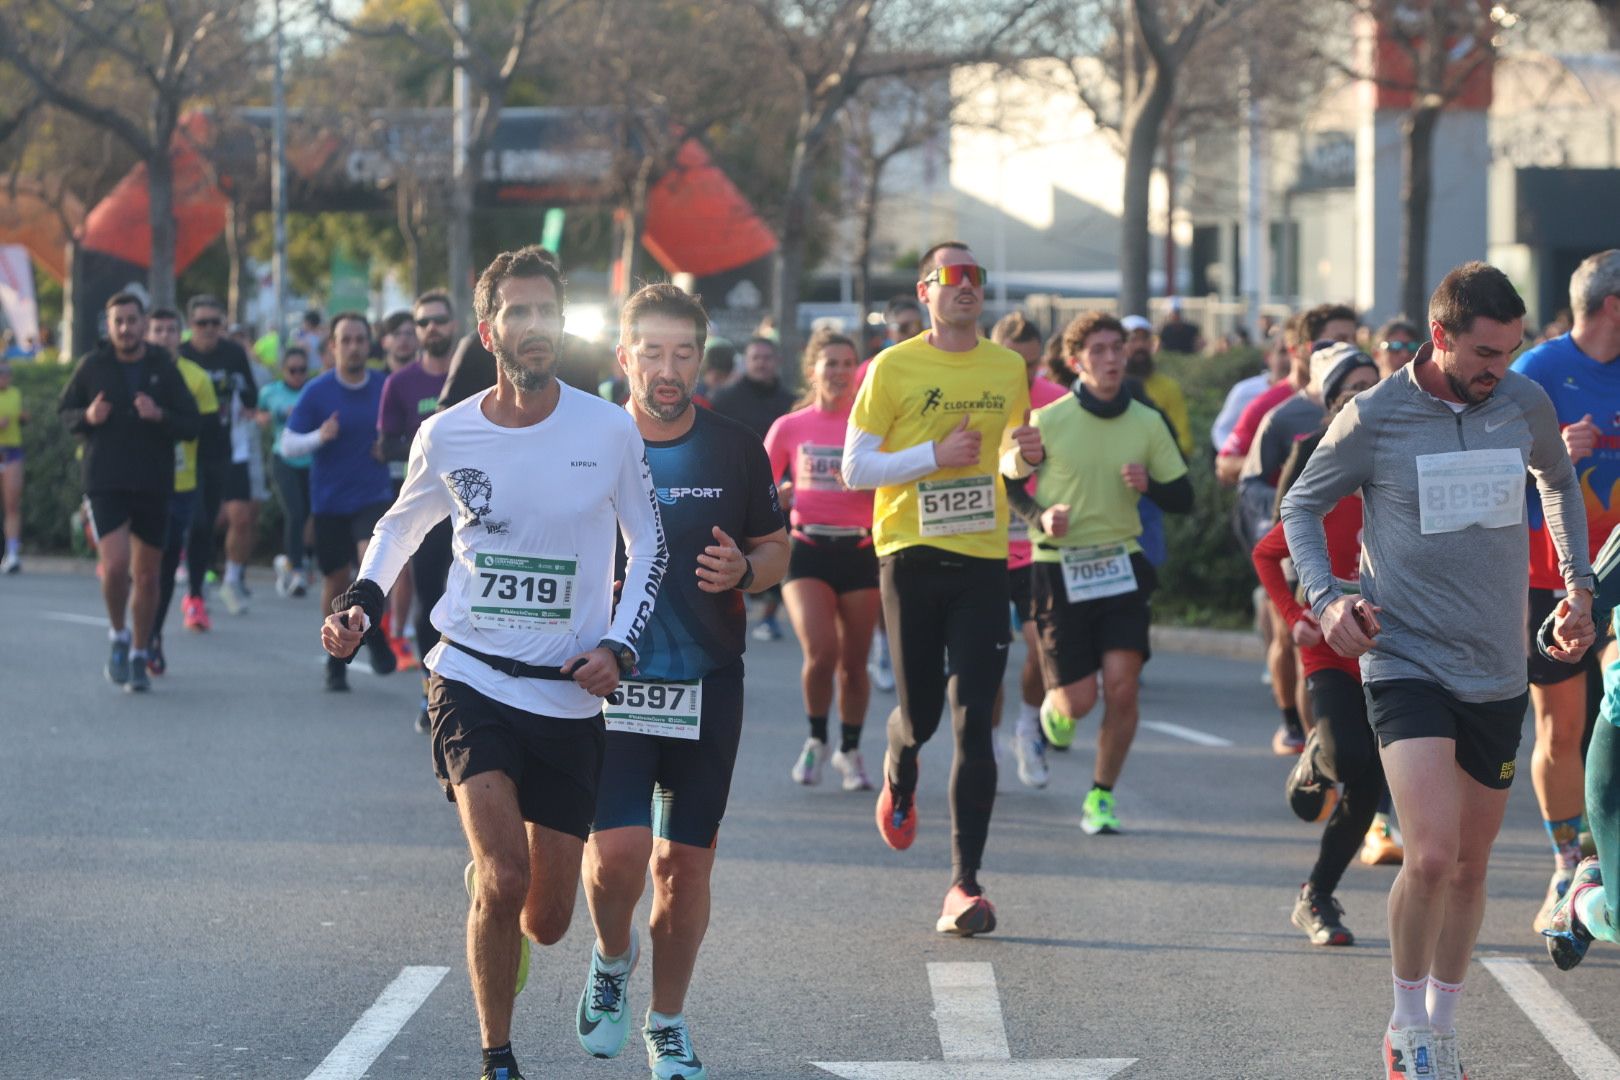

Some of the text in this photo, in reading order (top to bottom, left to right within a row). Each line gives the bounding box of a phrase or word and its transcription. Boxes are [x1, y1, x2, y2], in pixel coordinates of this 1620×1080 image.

[944, 400, 1004, 410] CLOCKWORK
[924, 490, 983, 513] 5122
[1069, 560, 1119, 581] 7055
[480, 572, 557, 604] 7319
